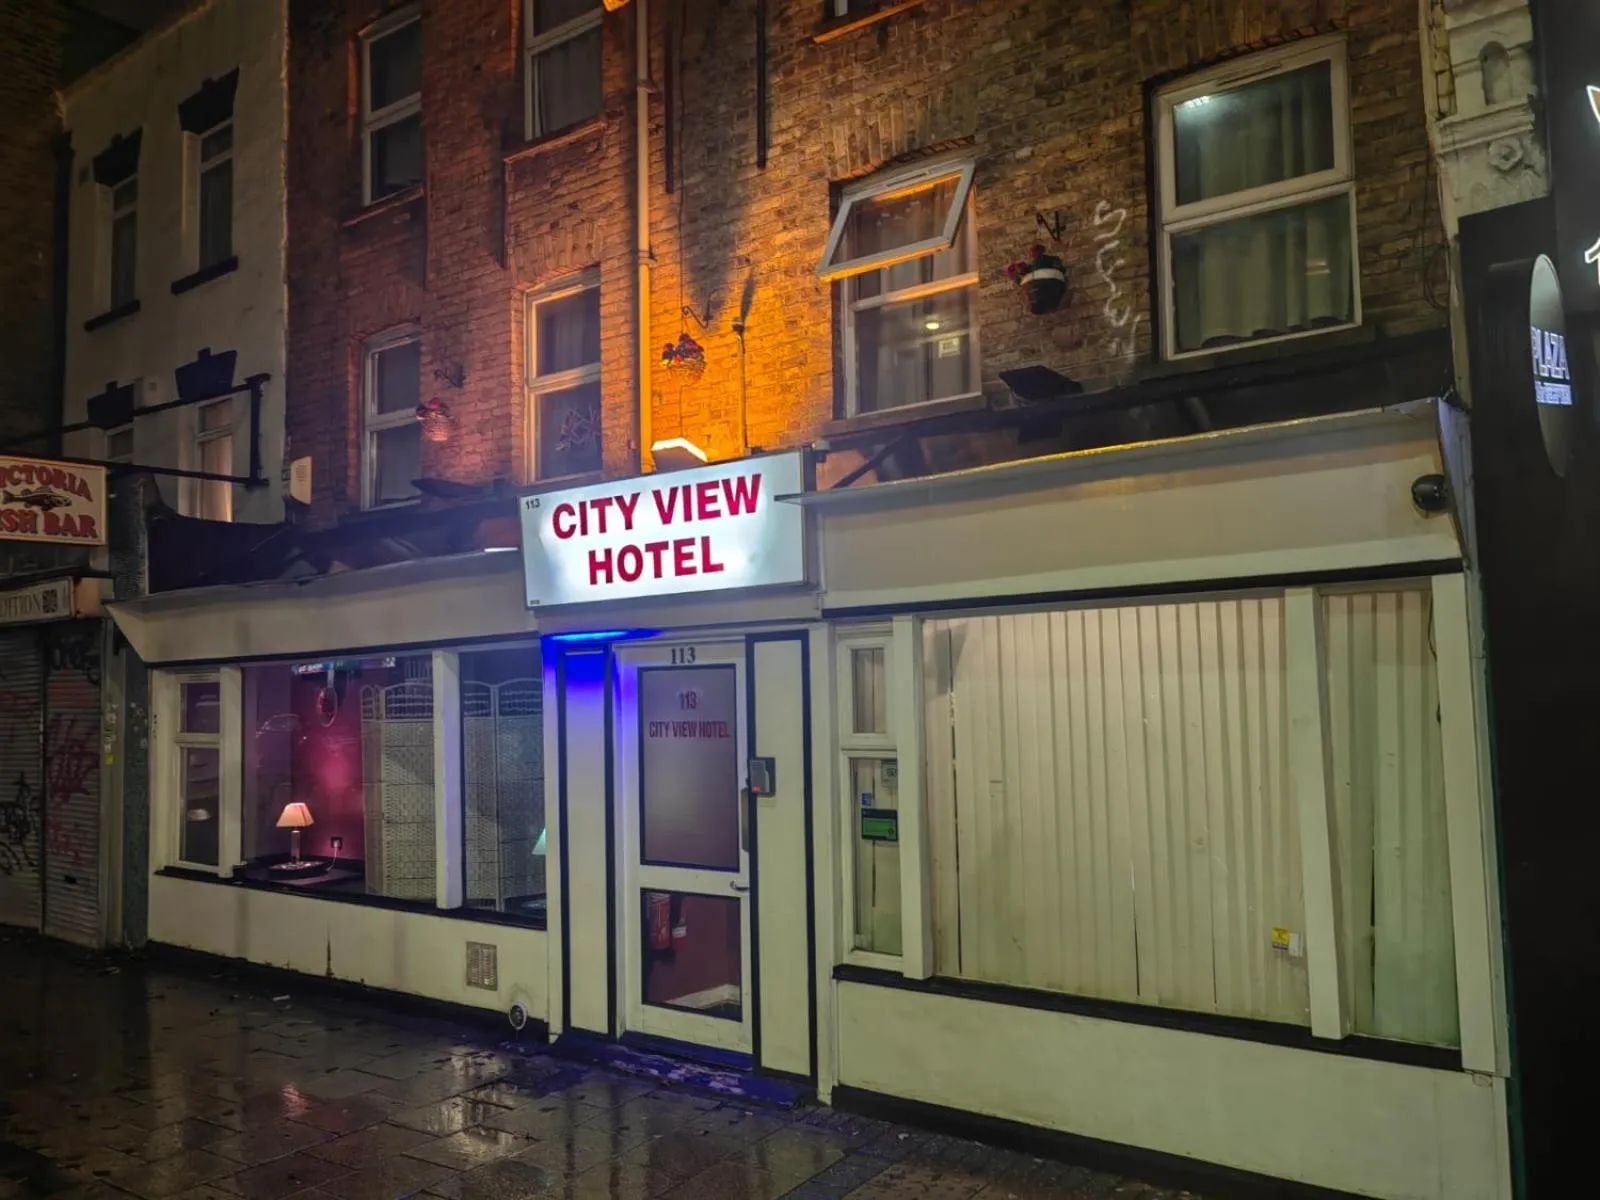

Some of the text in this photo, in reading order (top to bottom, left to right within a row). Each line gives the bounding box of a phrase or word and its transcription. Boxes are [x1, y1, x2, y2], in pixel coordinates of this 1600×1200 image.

[525, 498, 541, 510] 113
[552, 473, 762, 540] CITY VIEW
[42, 511, 99, 539] BAR
[588, 536, 724, 585] HOTEL
[671, 646, 696, 665] 113
[679, 690, 697, 710] 113
[649, 721, 731, 739] CITY VIEW HOTEL
